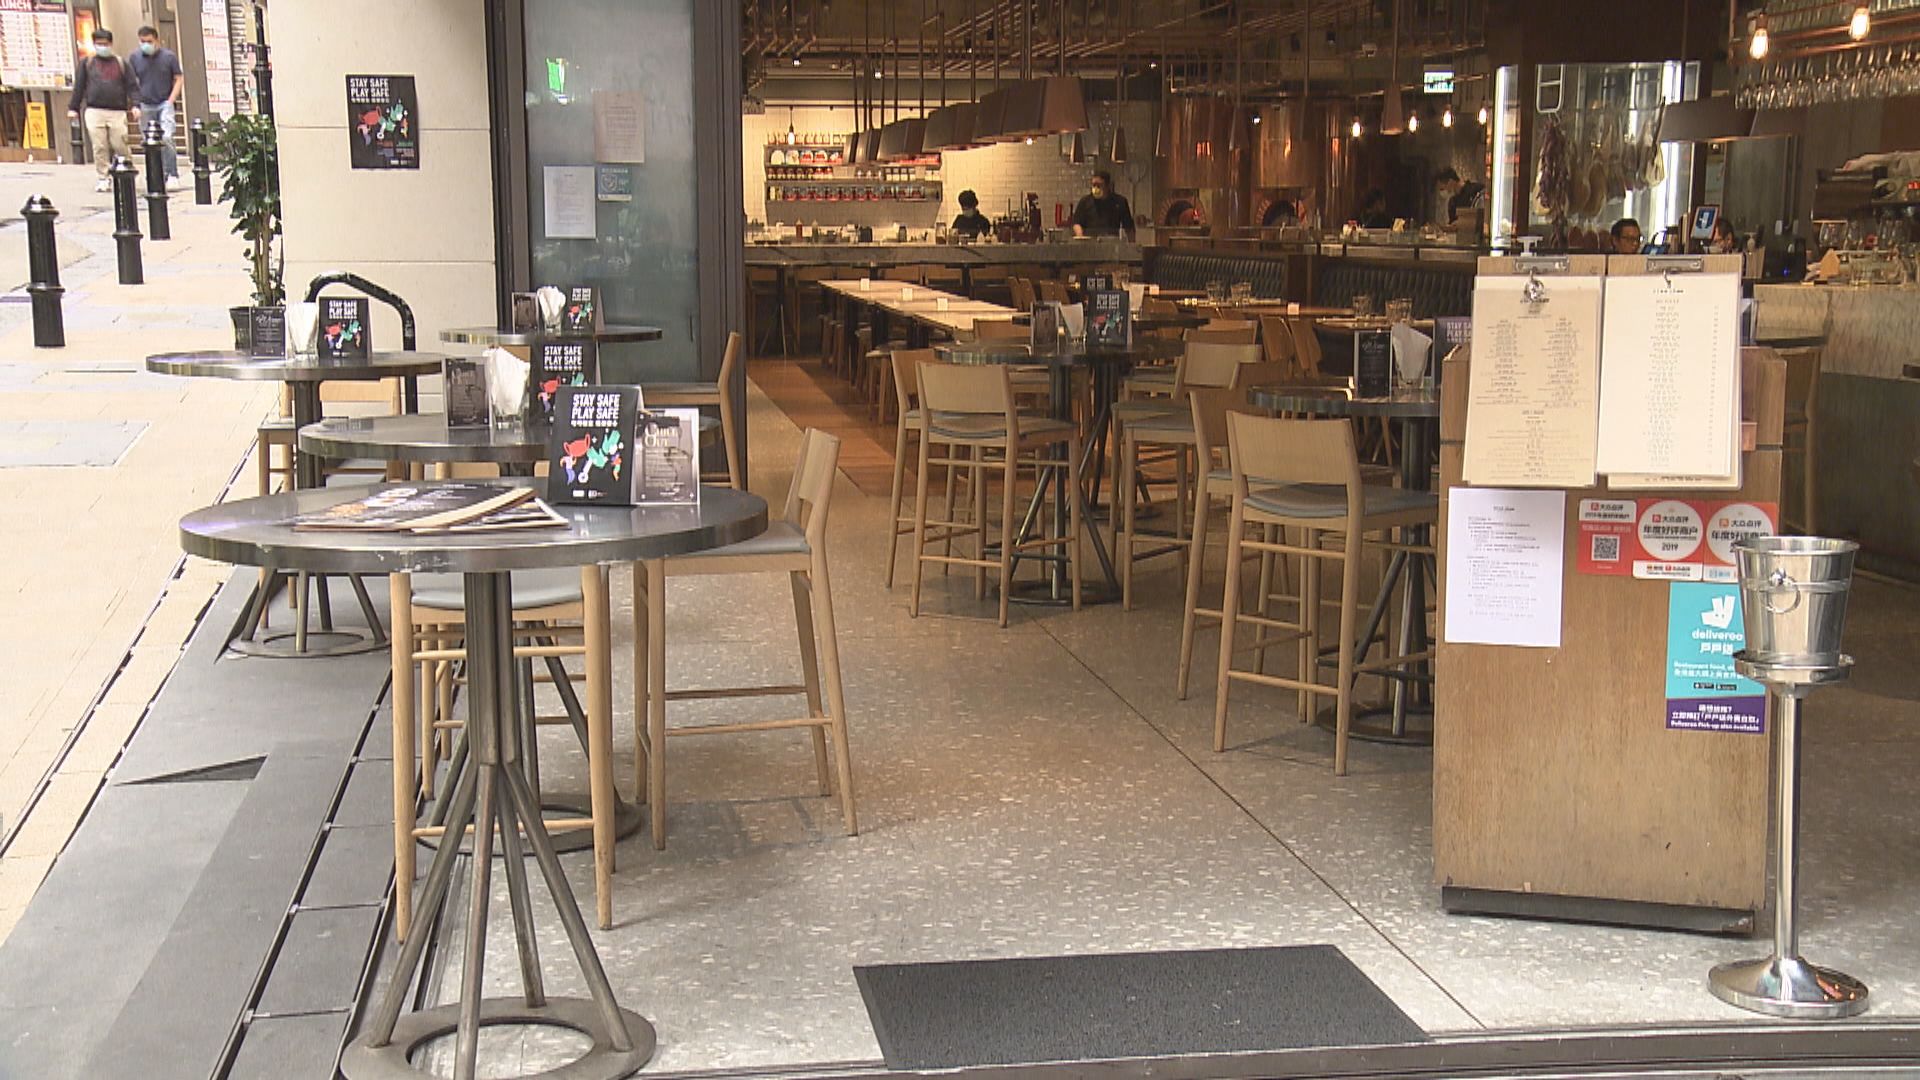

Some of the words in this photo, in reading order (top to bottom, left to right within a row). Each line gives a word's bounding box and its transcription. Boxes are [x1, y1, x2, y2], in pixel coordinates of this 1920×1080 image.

[350, 78, 368, 87] STAY
[370, 79, 388, 88] SAFE
[351, 88, 369, 97] PLAY
[371, 88, 389, 97] SAFE
[1446, 322, 1461, 330] STAY
[1446, 330, 1461, 338] PLAY
[545, 346, 562, 355] STAY
[564, 346, 582, 355] SAFE
[544, 356, 562, 365] PLAY
[564, 356, 582, 365] SAFE
[573, 394, 595, 407] STAY
[597, 394, 620, 407] SAFE
[571, 407, 595, 419] PLAY
[596, 407, 619, 419] SAFE
[1662, 515, 1689, 523] 大众点评
[1643, 525, 1698, 536] 年度好评商户
[1661, 542, 1678, 551] 2019
[1692, 629, 1743, 641] deliveroo
[1671, 720, 1698, 728] Deliveroo
